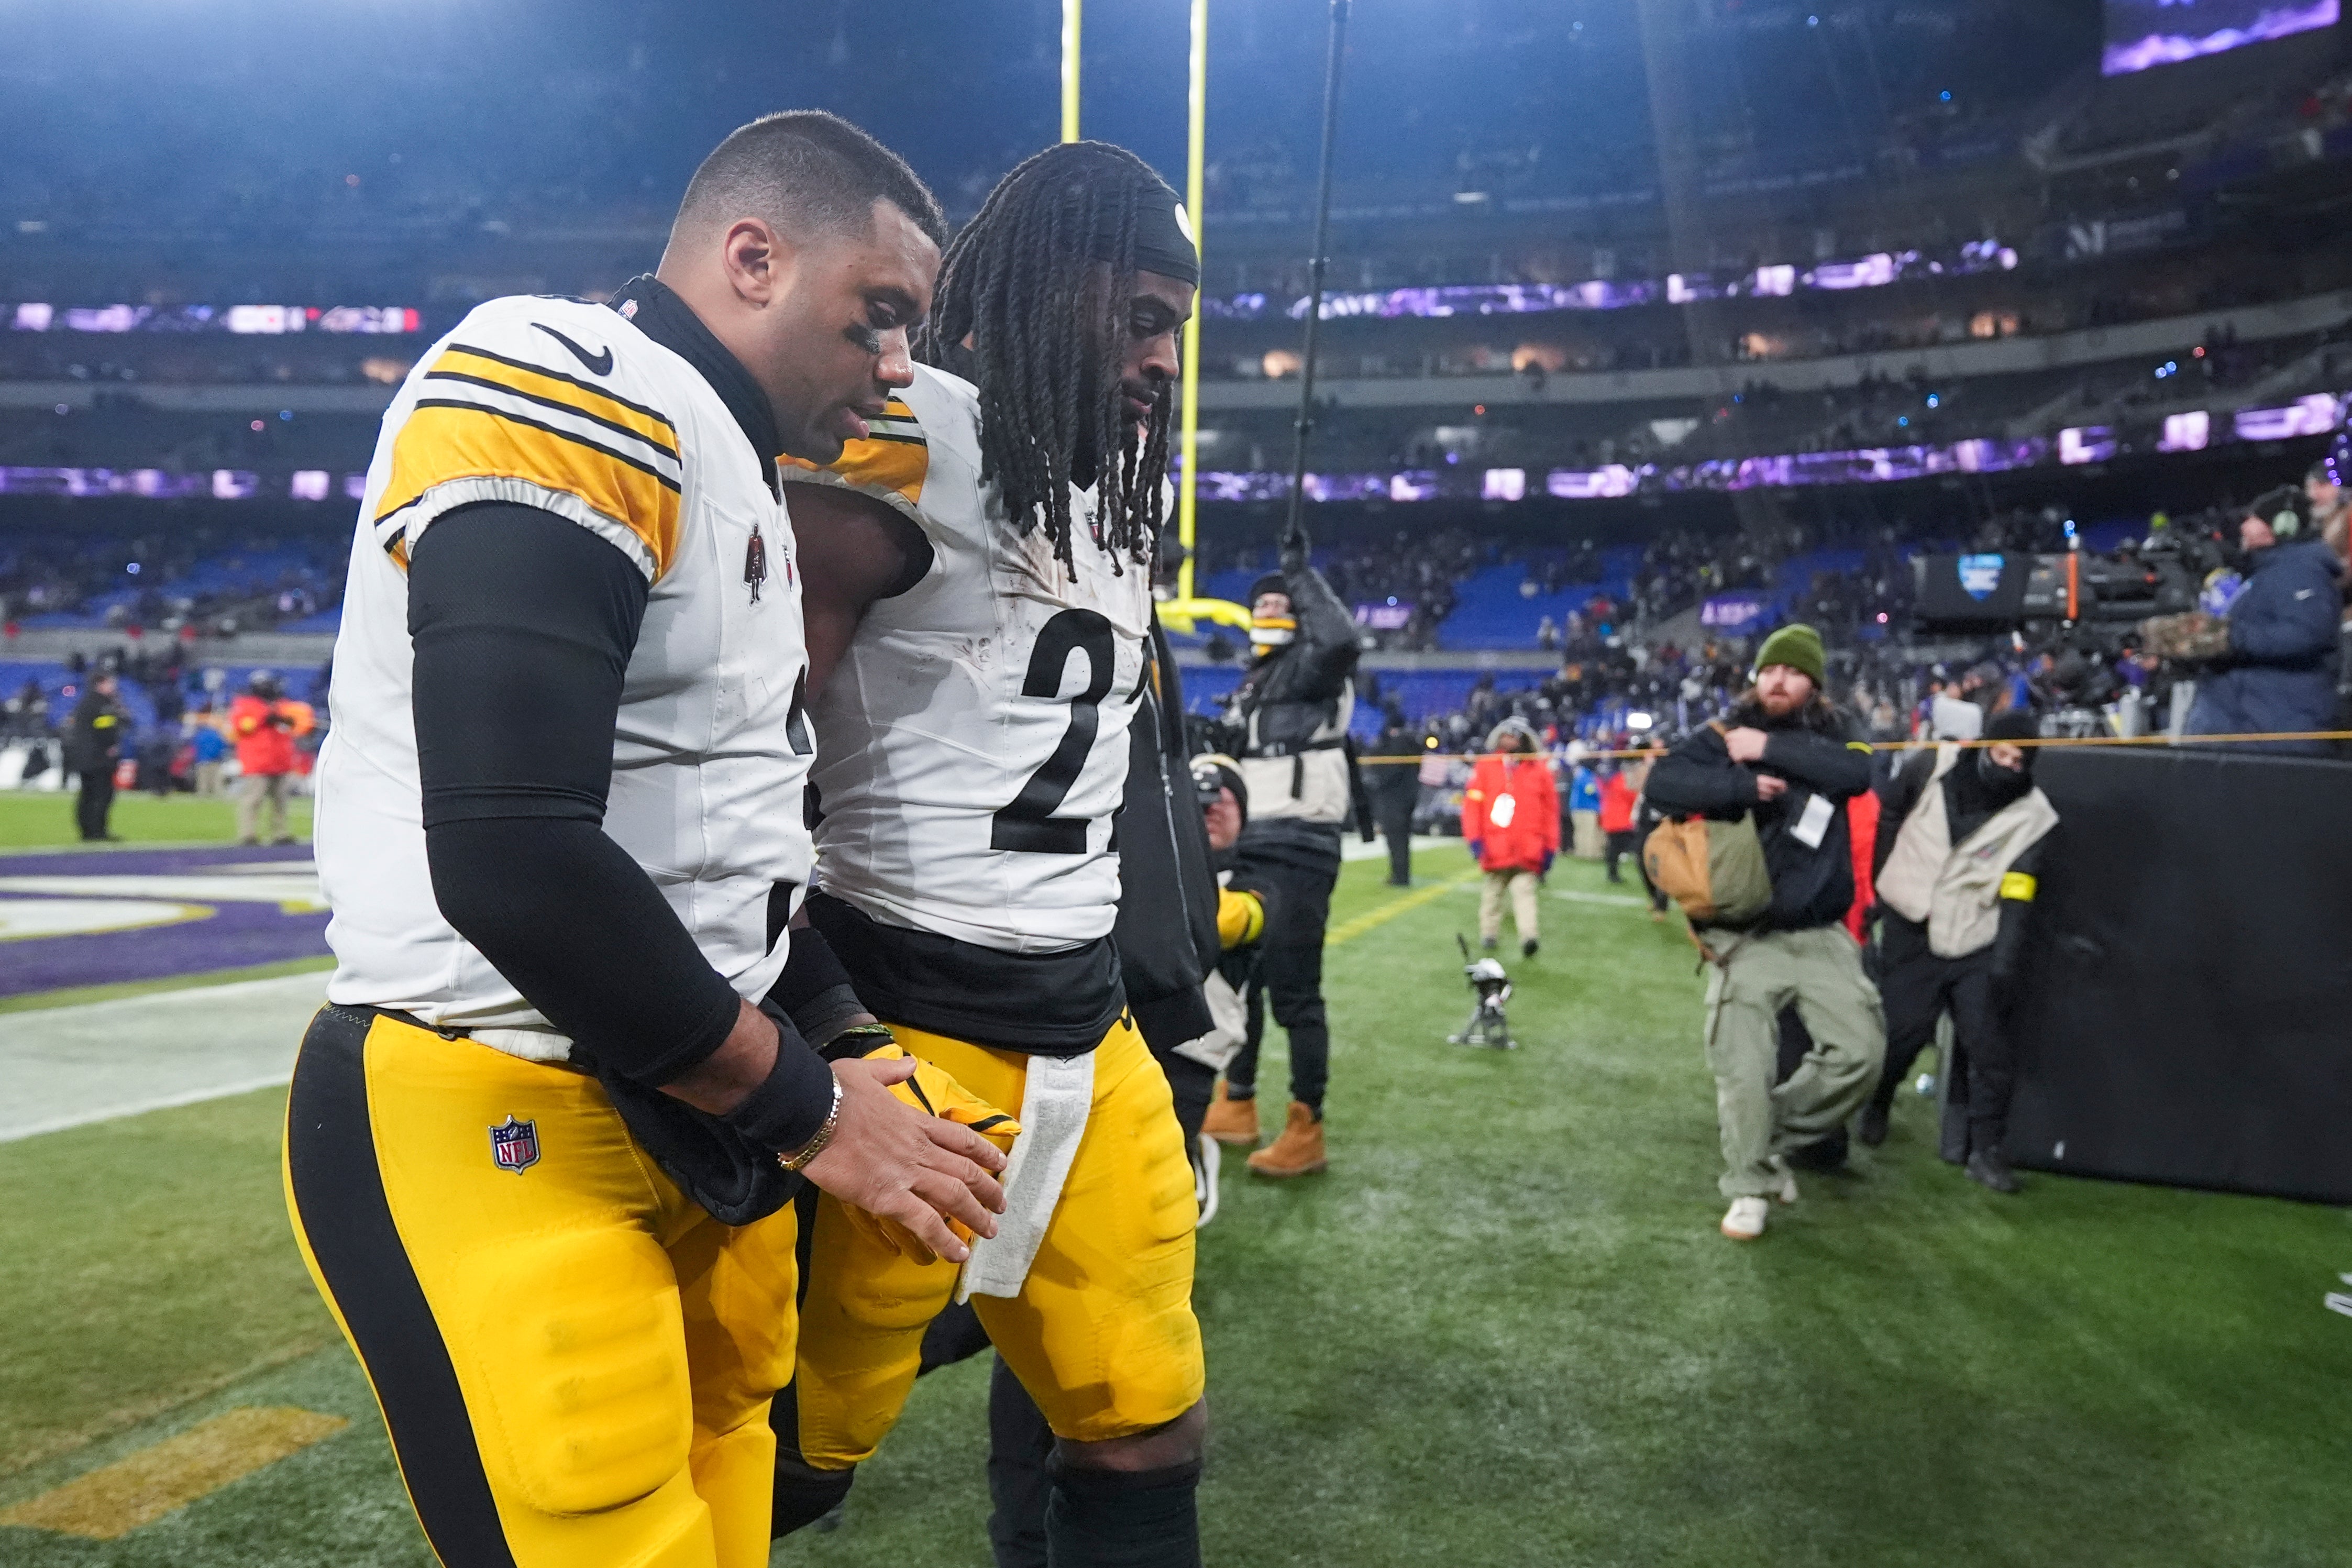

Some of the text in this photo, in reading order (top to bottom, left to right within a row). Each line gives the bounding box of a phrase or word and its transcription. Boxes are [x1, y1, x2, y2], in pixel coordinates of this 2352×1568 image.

[624, 302, 636, 317] NFL
[990, 608, 1150, 855] 2
[499, 1140, 534, 1163] NFL
